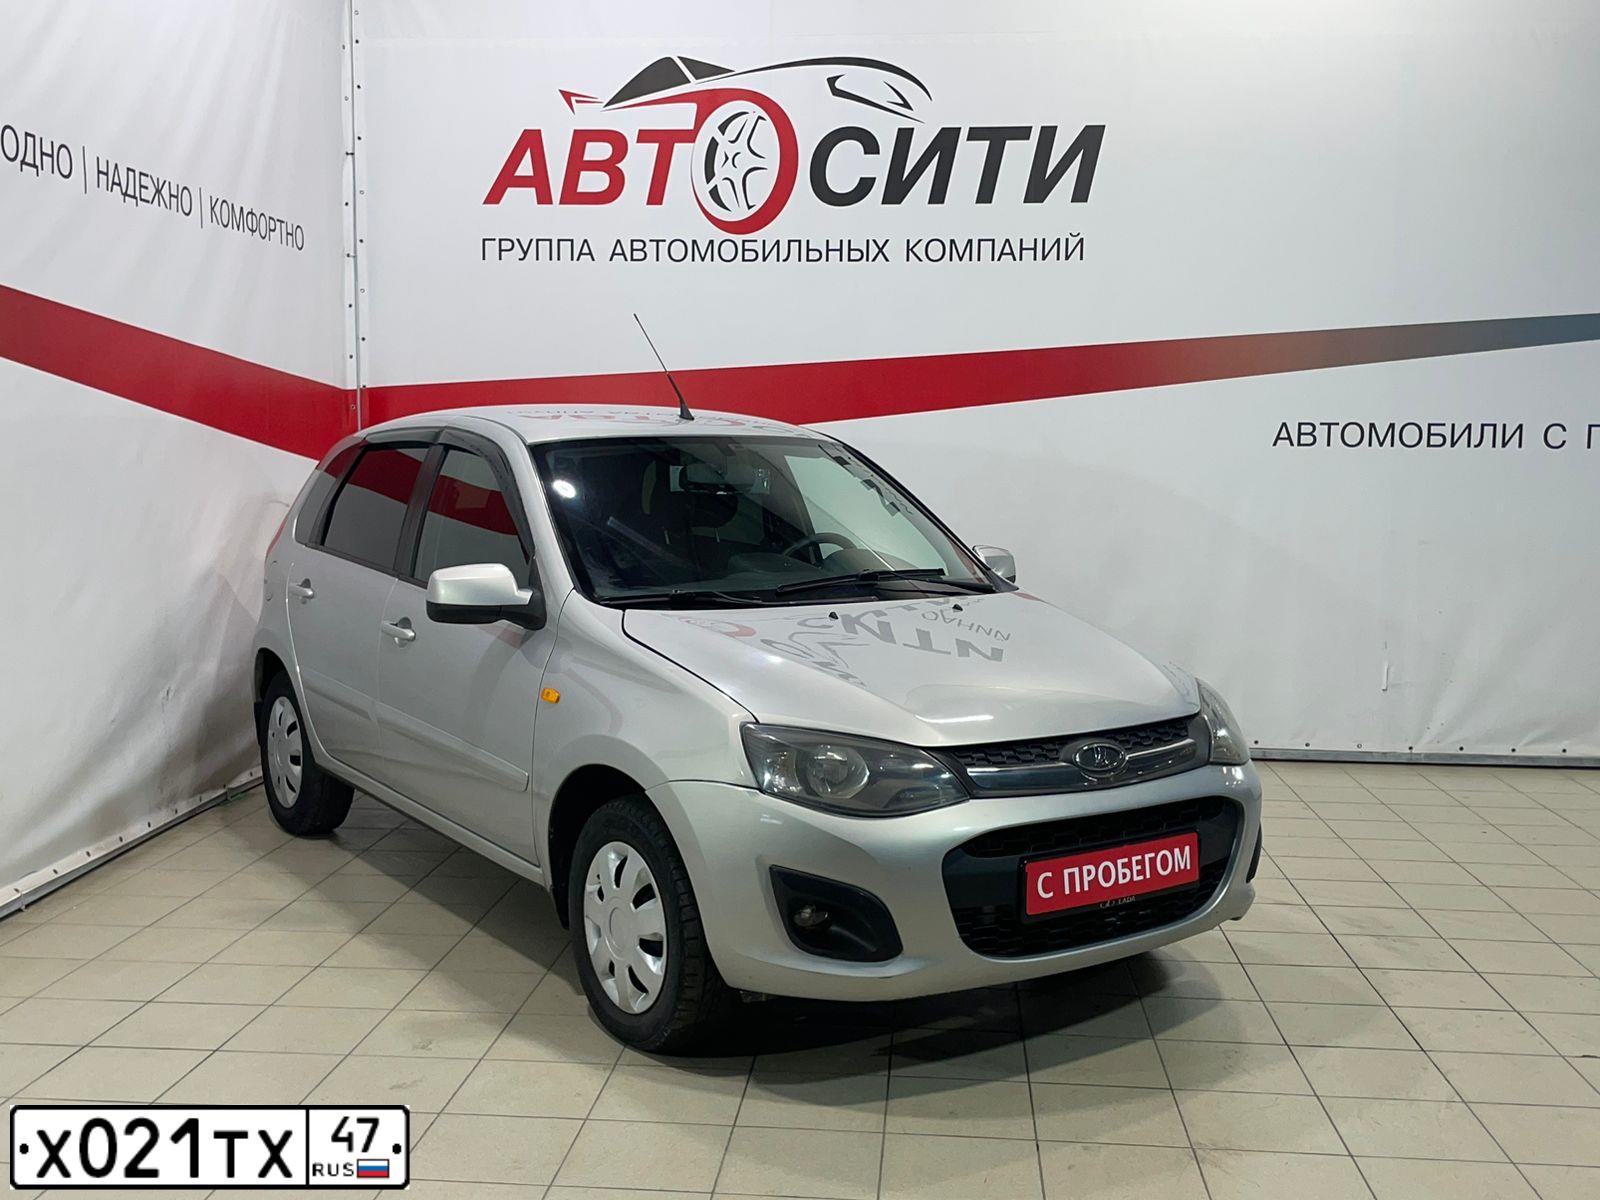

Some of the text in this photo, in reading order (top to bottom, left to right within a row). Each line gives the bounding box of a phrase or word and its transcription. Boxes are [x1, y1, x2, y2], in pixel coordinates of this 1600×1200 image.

[483, 88, 1106, 235] АВТОСИТИ
[96, 156, 193, 217] НАДЕЖНО
[209, 195, 305, 251] КОМФОРТНО
[482, 232, 1084, 263] ГРУППА АВТОМОБИЛЬНЫХ КОМПАНИЙ
[1272, 421, 1524, 449] АВТОМОБИЛИ
[1543, 422, 1567, 450] С
[1037, 845, 1191, 899] С ПРОБЕГОМ
